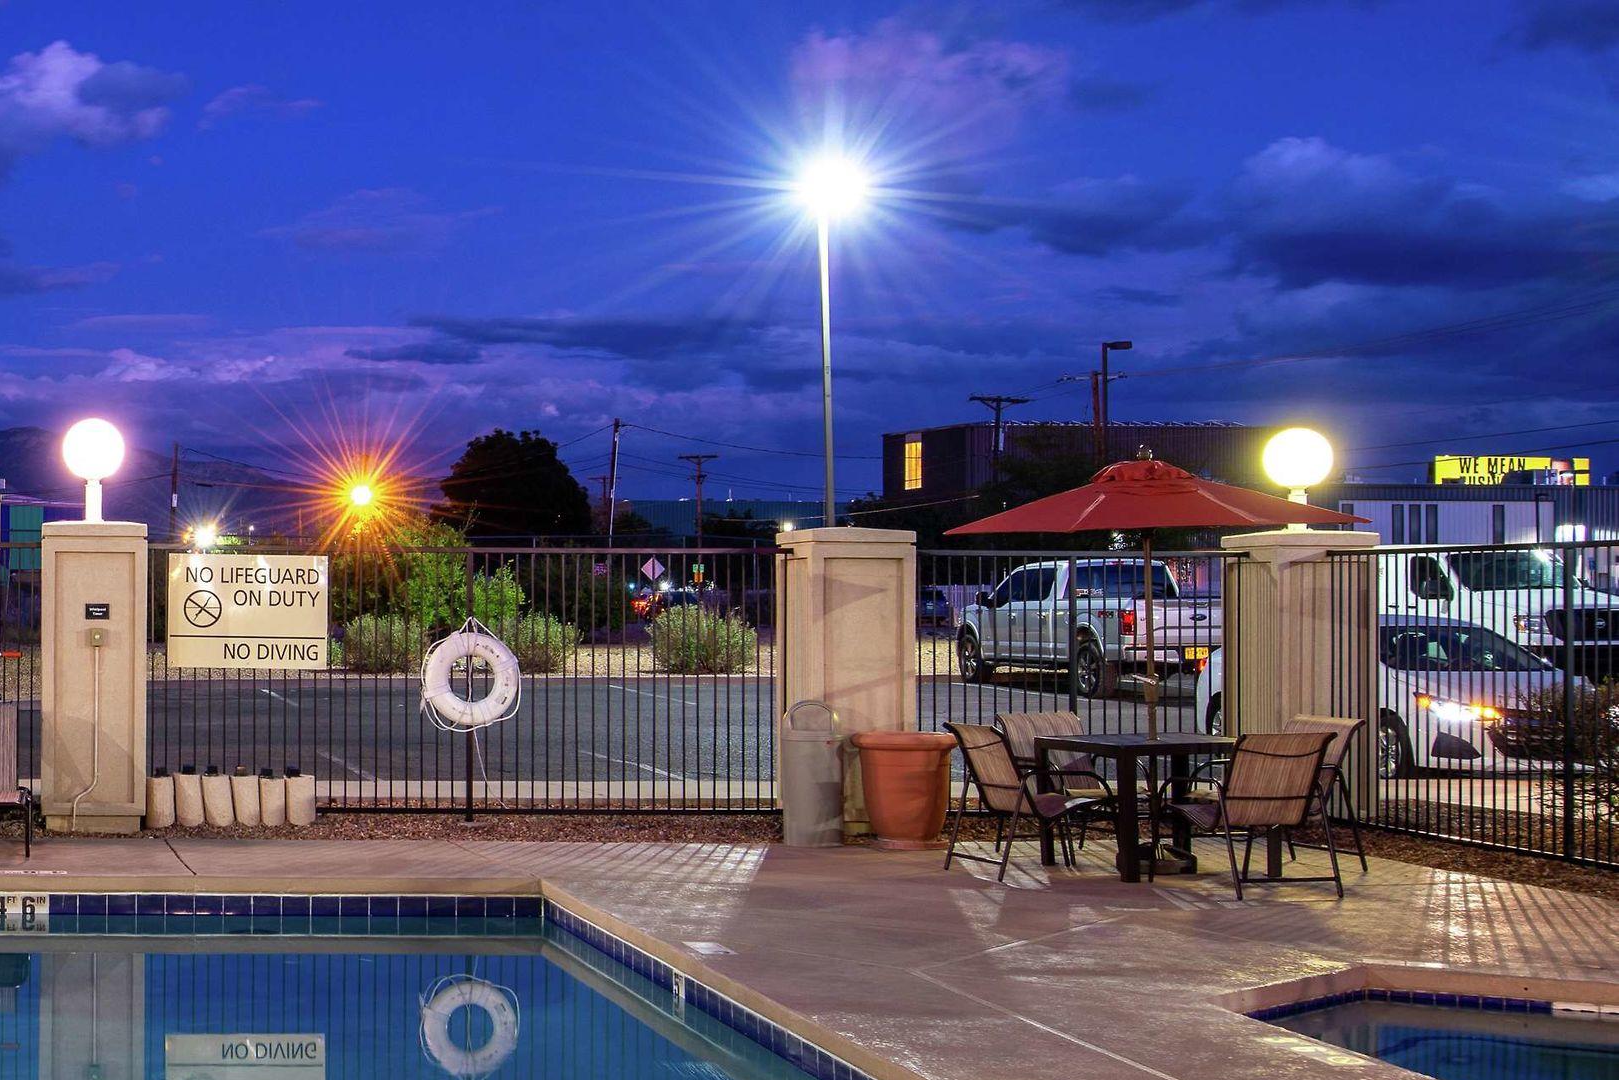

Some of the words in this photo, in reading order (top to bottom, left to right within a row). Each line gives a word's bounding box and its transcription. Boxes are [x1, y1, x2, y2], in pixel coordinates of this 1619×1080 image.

[1459, 457, 1479, 474] WE
[1487, 457, 1526, 474] MEAN
[185, 566, 214, 583] NO
[220, 567, 320, 585] LIFEGUARD
[233, 590, 262, 607] ON
[269, 590, 320, 607] DUTY
[223, 643, 251, 660] NO
[257, 644, 319, 661] DIVING
[7, 896, 17, 904] FT
[21, 896, 36, 914] 6
[36, 896, 46, 904] IN
